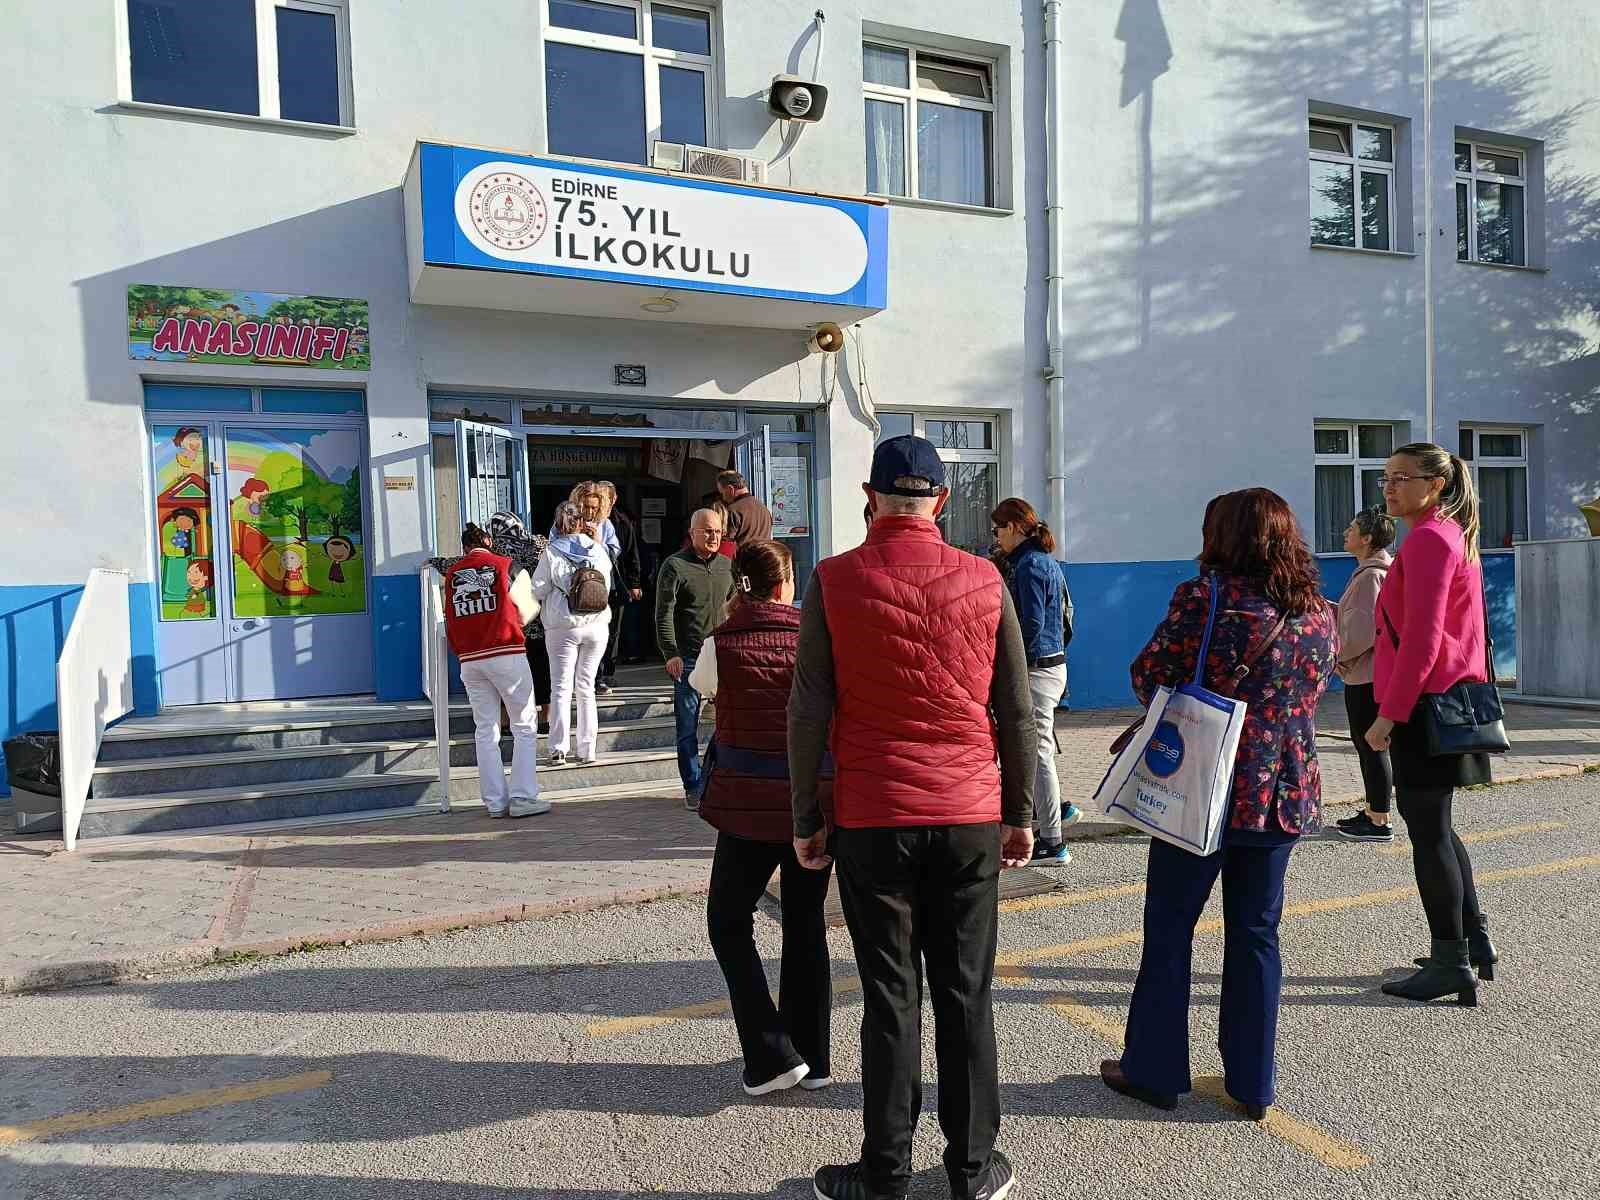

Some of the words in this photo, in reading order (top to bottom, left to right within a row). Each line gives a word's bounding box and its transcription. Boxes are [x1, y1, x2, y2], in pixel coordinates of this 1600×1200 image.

[551, 178, 617, 200] EDİRNE
[553, 197, 608, 228] 75.
[622, 205, 681, 237] YIL
[555, 224, 750, 277] İLKOKULU
[153, 317, 349, 361] ANASINIFI
[454, 595, 497, 617] RHU
